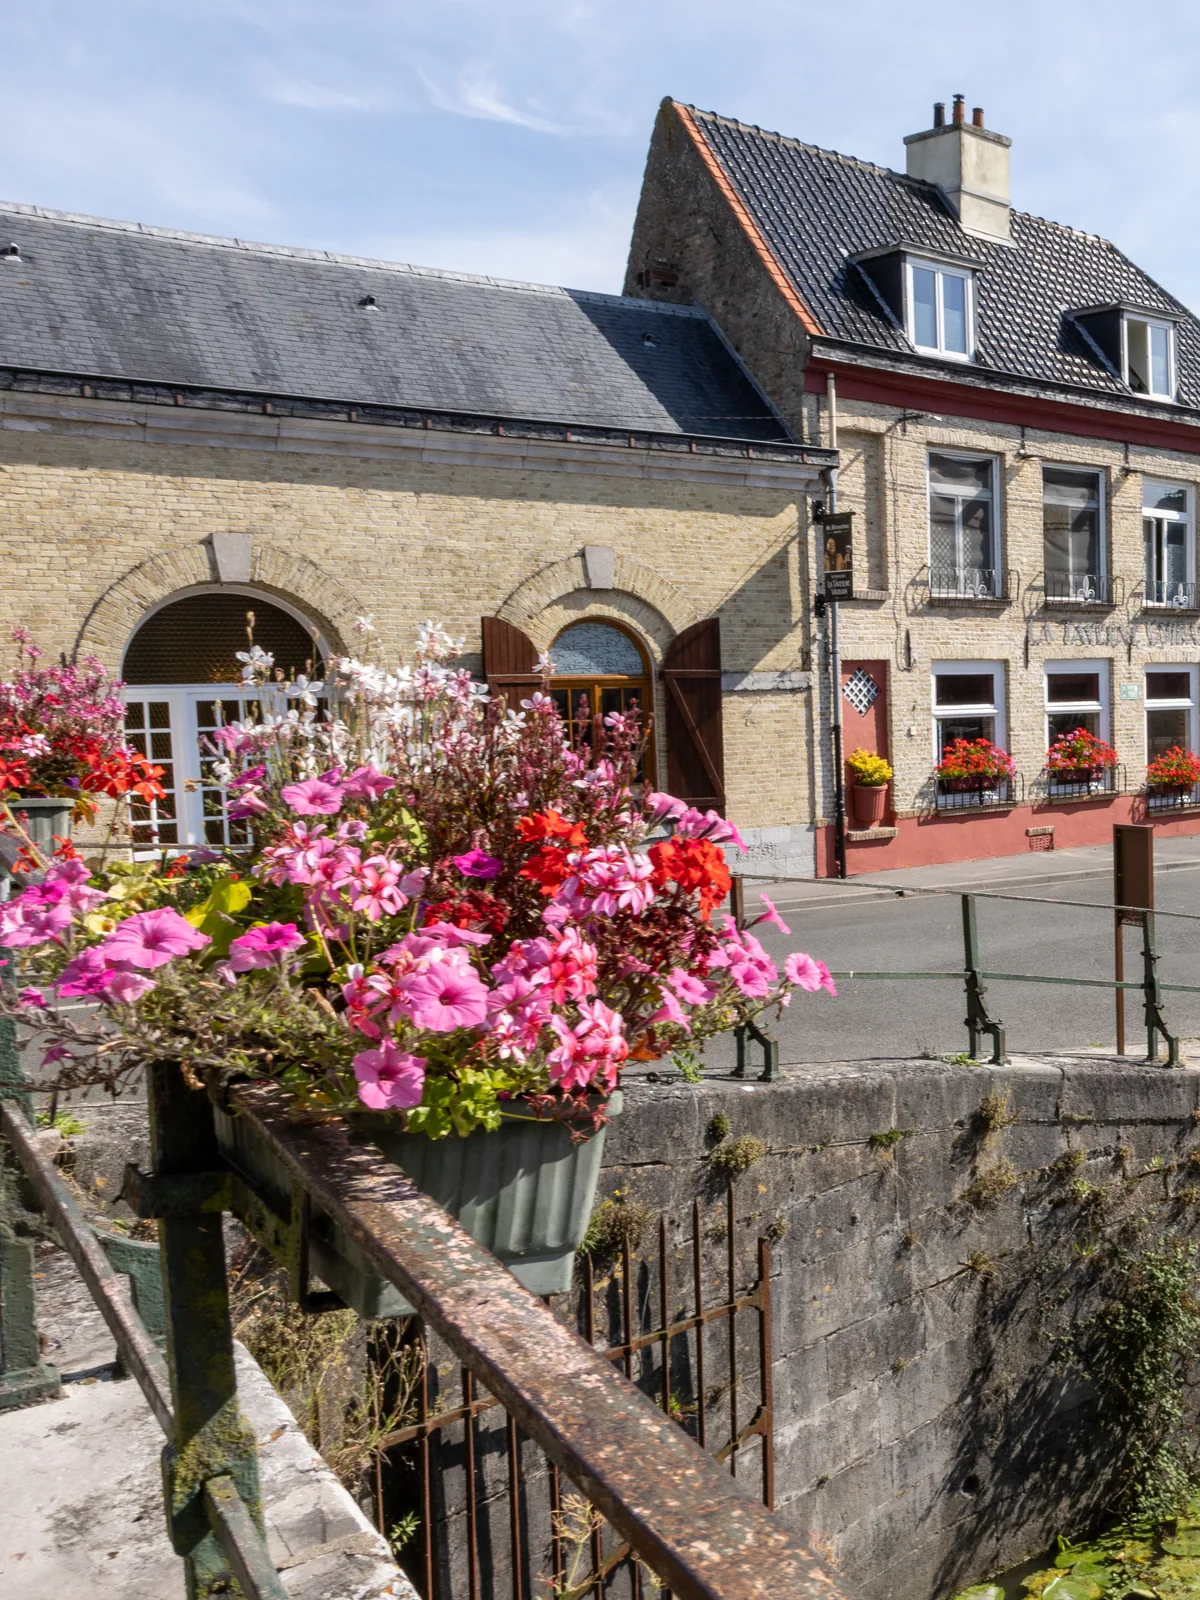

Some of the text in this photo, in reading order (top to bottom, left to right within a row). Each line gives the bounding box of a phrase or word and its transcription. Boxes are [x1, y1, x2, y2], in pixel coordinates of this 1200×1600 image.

[832, 579, 851, 588] TAVERNE
[831, 588, 848, 596] VAUBAN
[1029, 619, 1055, 646] LA
[1063, 620, 1139, 647] TAVERNE
